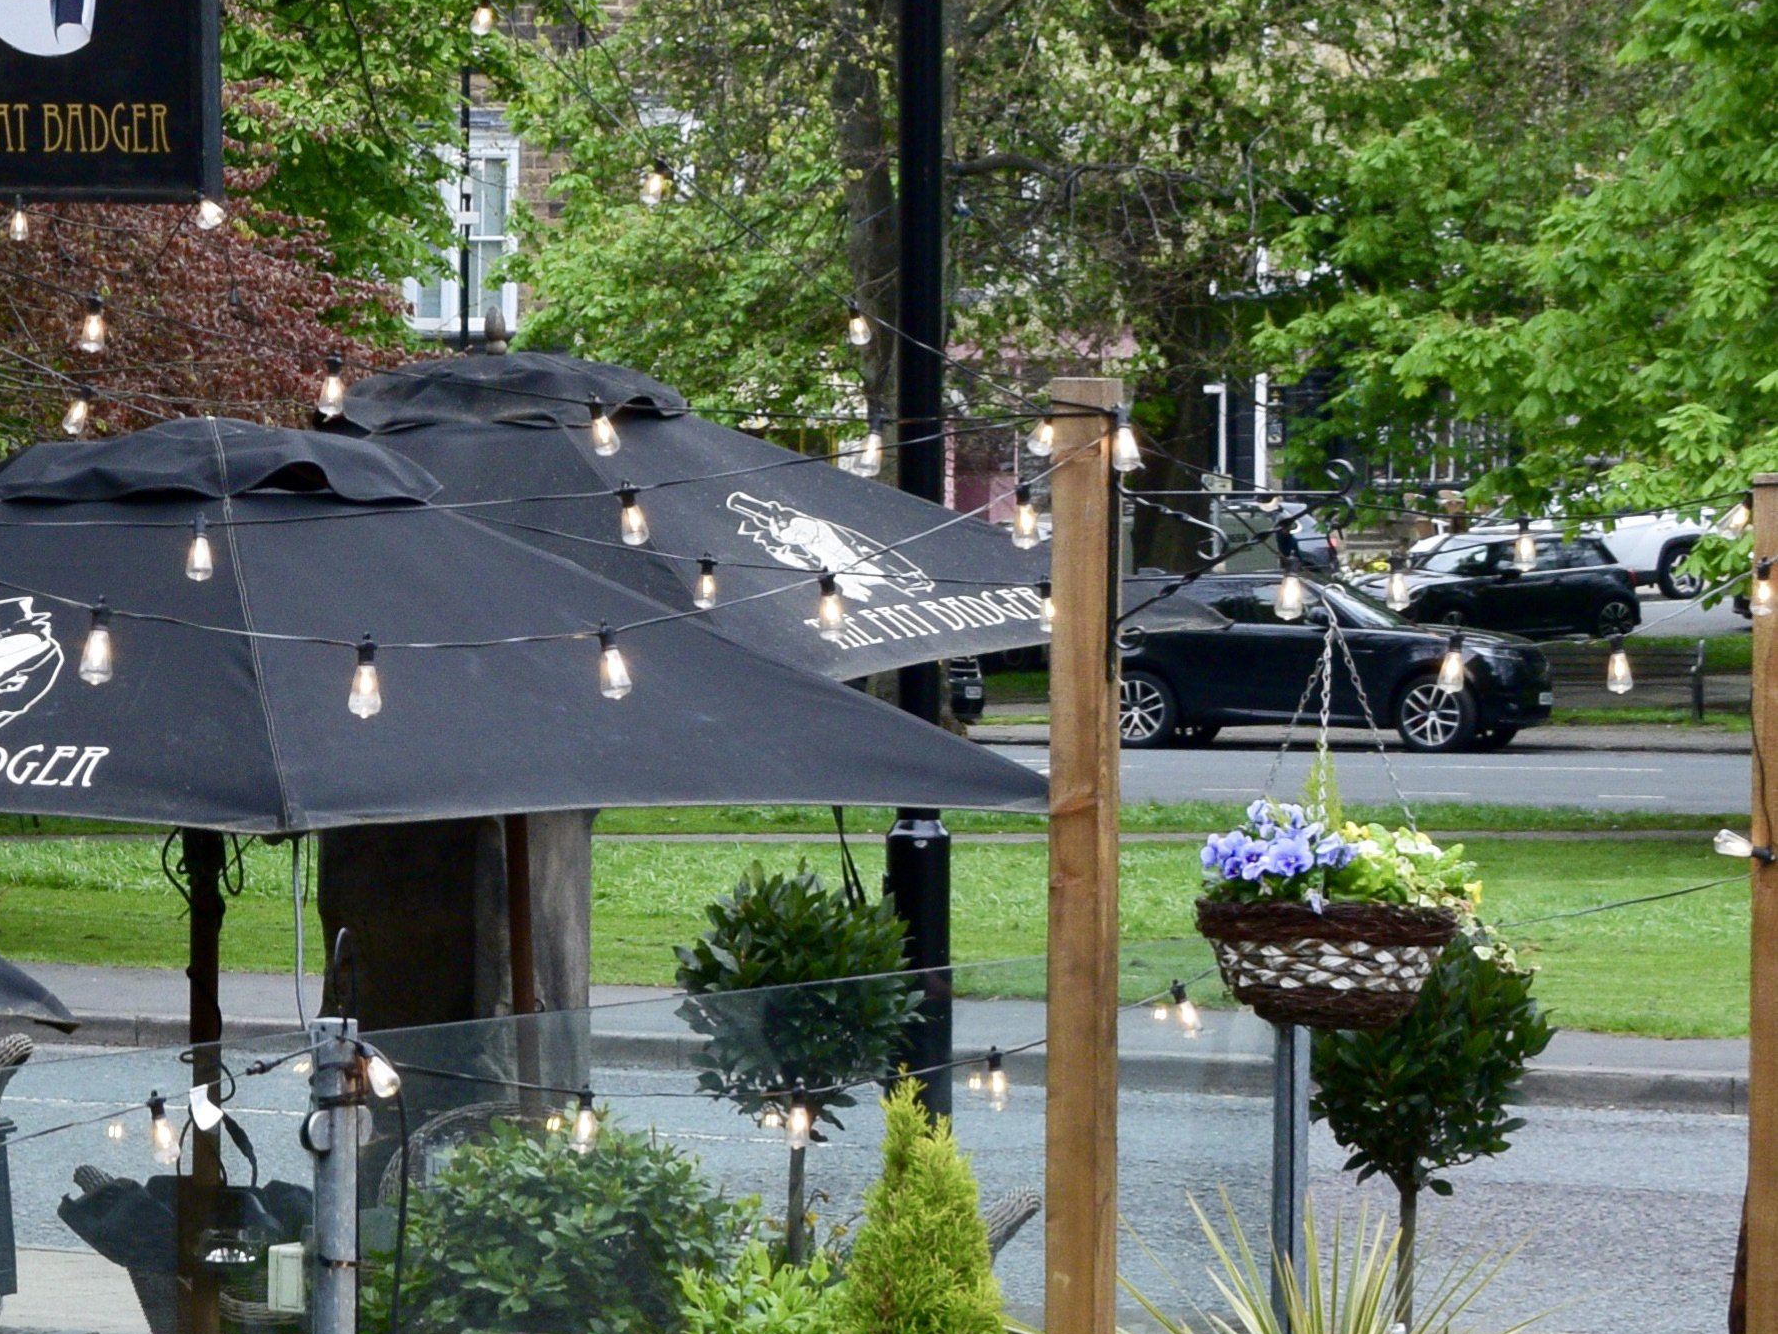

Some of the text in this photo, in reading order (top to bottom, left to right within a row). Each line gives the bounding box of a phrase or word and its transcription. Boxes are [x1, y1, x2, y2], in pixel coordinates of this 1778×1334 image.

[42, 103, 170, 152] BADGER
[858, 603, 940, 640] FAT
[918, 586, 1043, 631] BADGER
